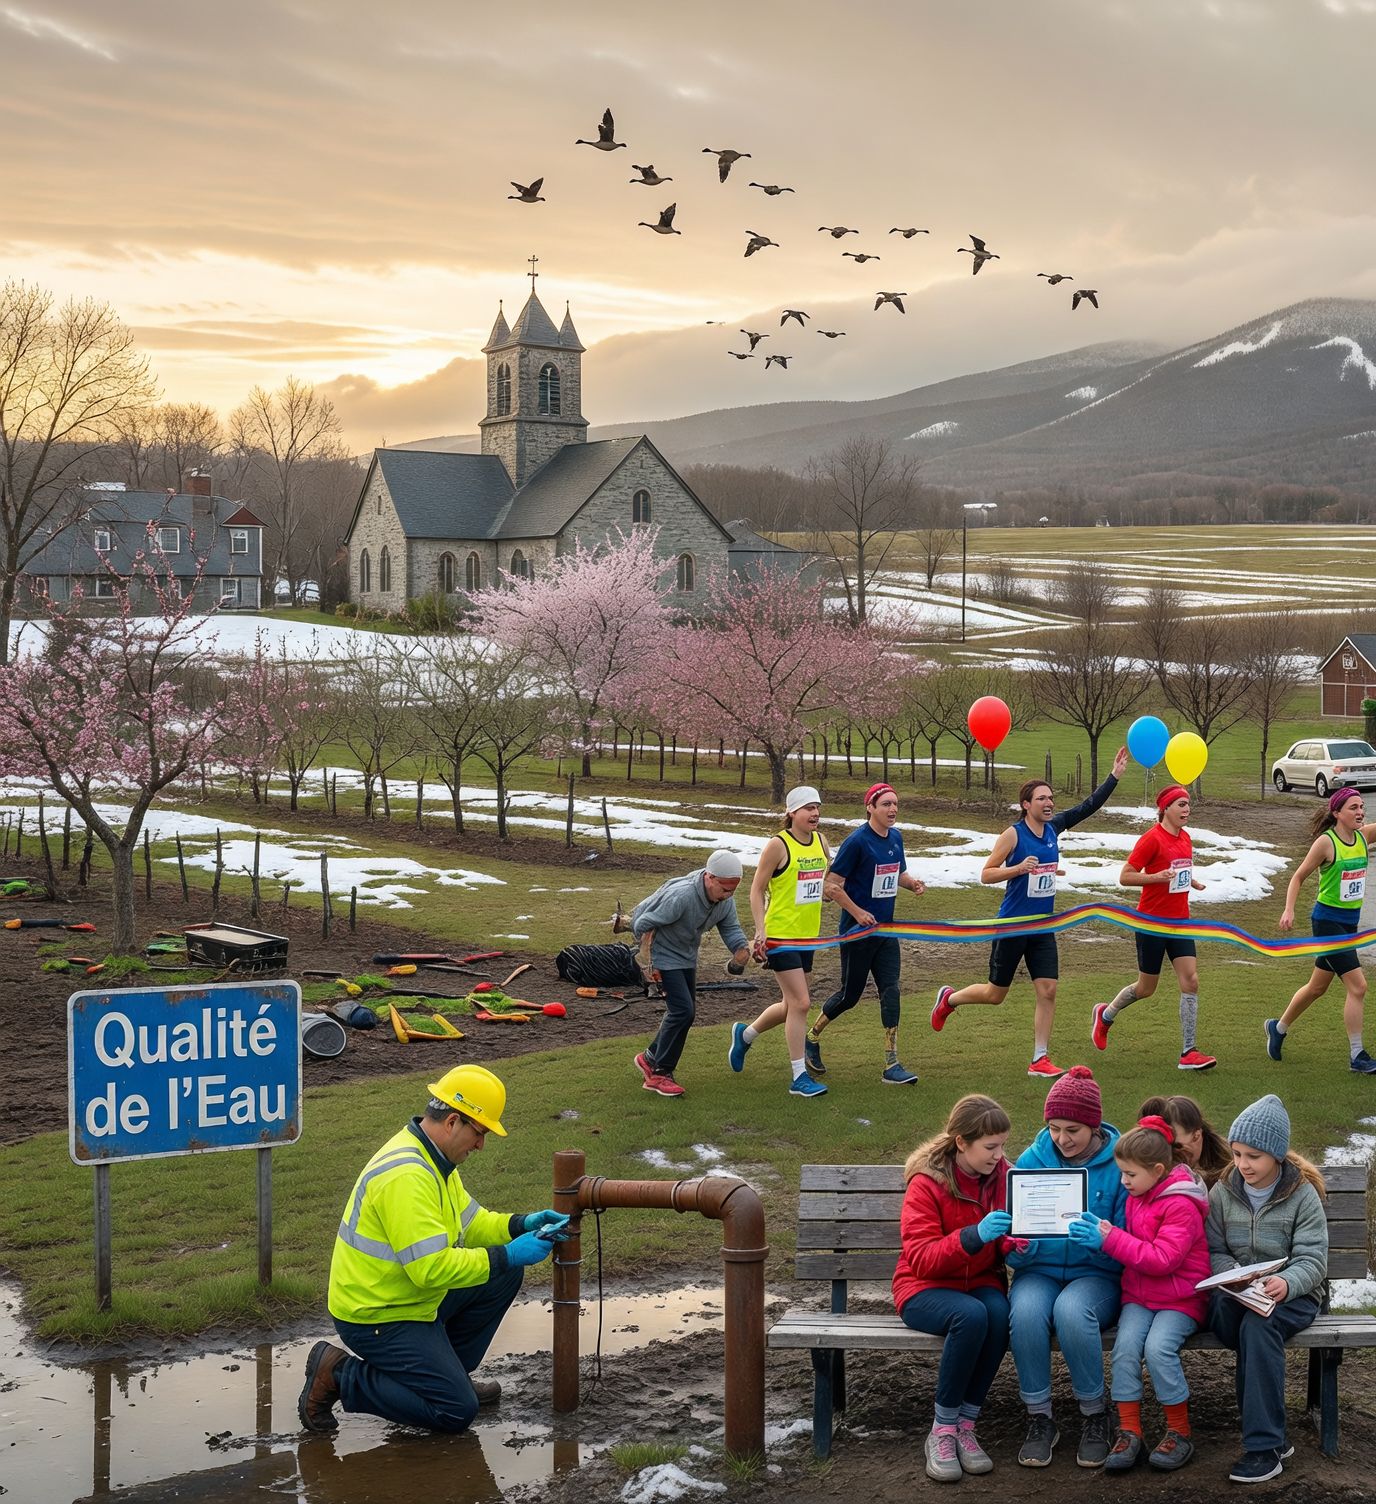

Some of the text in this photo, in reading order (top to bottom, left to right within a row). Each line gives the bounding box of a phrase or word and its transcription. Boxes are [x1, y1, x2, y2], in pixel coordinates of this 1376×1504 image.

[94, 1003, 277, 1069] Qualité
[85, 1074, 286, 1137] de l’Eau
